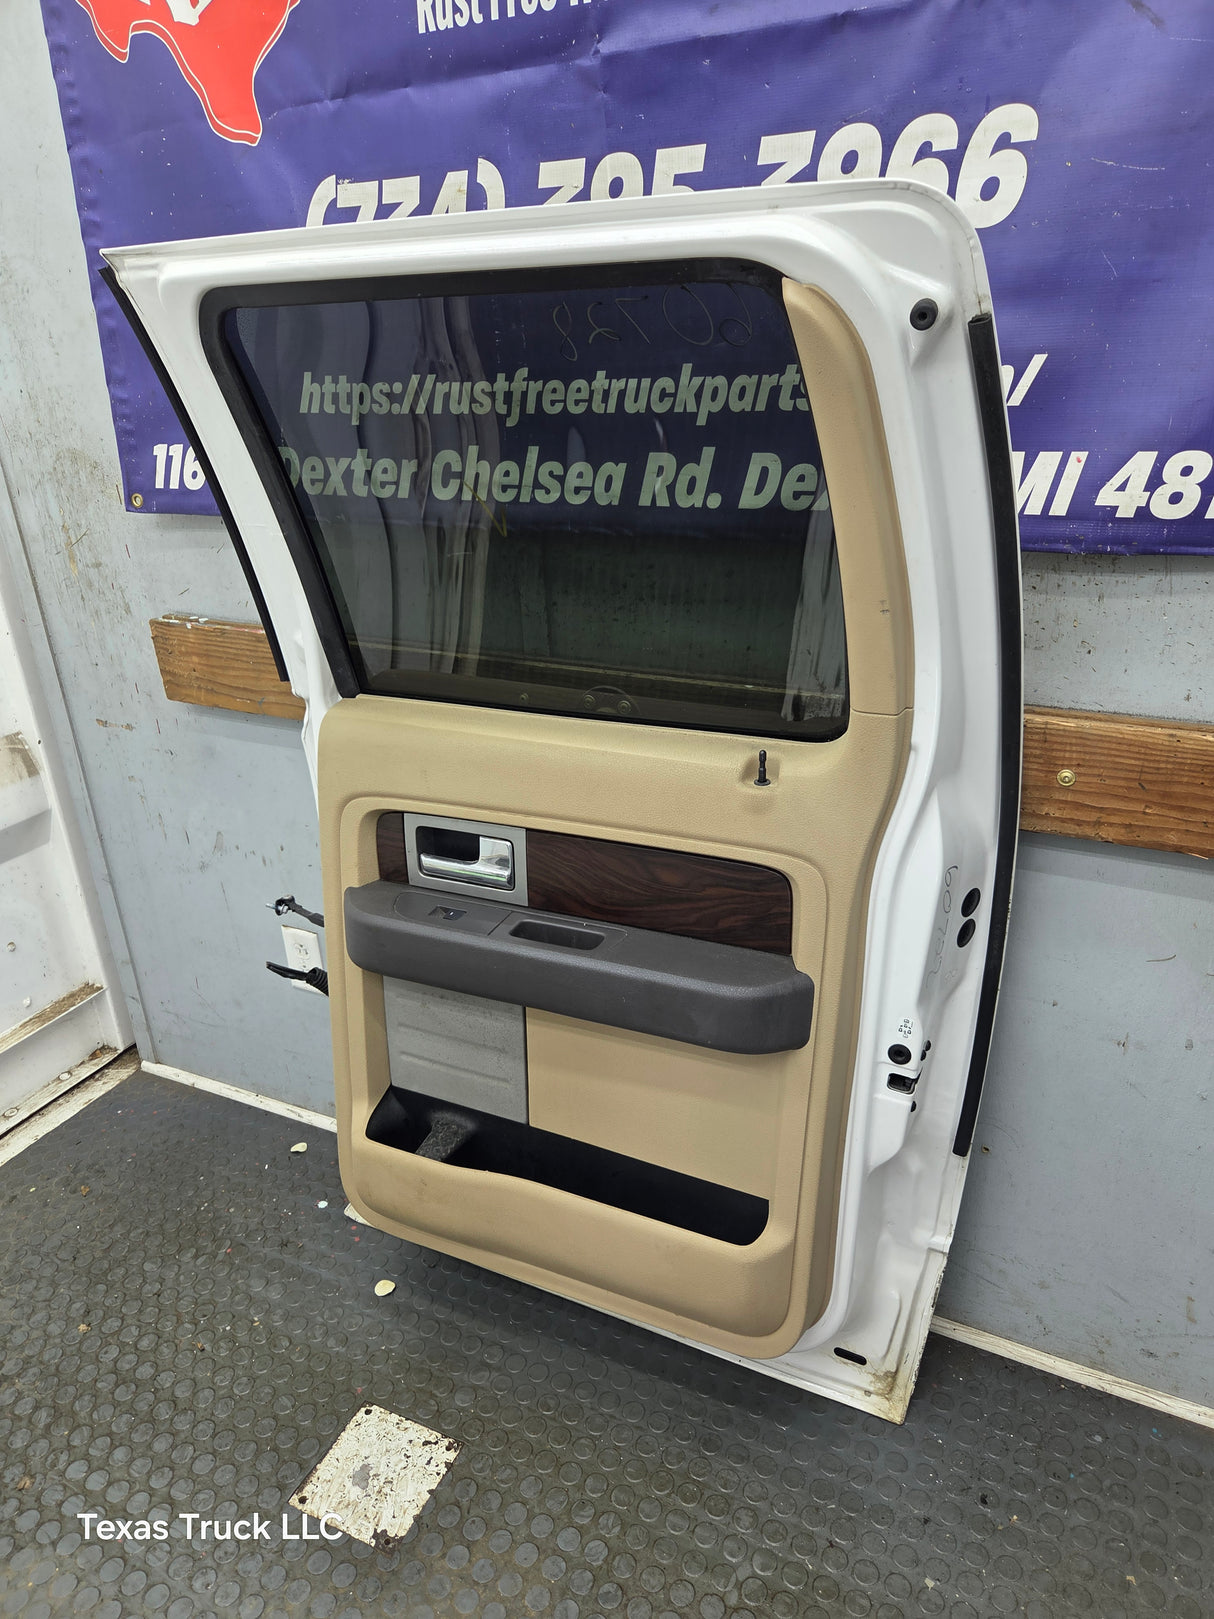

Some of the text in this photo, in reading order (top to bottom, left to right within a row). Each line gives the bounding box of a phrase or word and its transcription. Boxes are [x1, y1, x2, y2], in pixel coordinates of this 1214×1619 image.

[431, 445, 627, 506] Chelsea
[638, 446, 722, 508] Rd.
[1011, 451, 1089, 516] MI
[1094, 450, 1214, 519] 48
